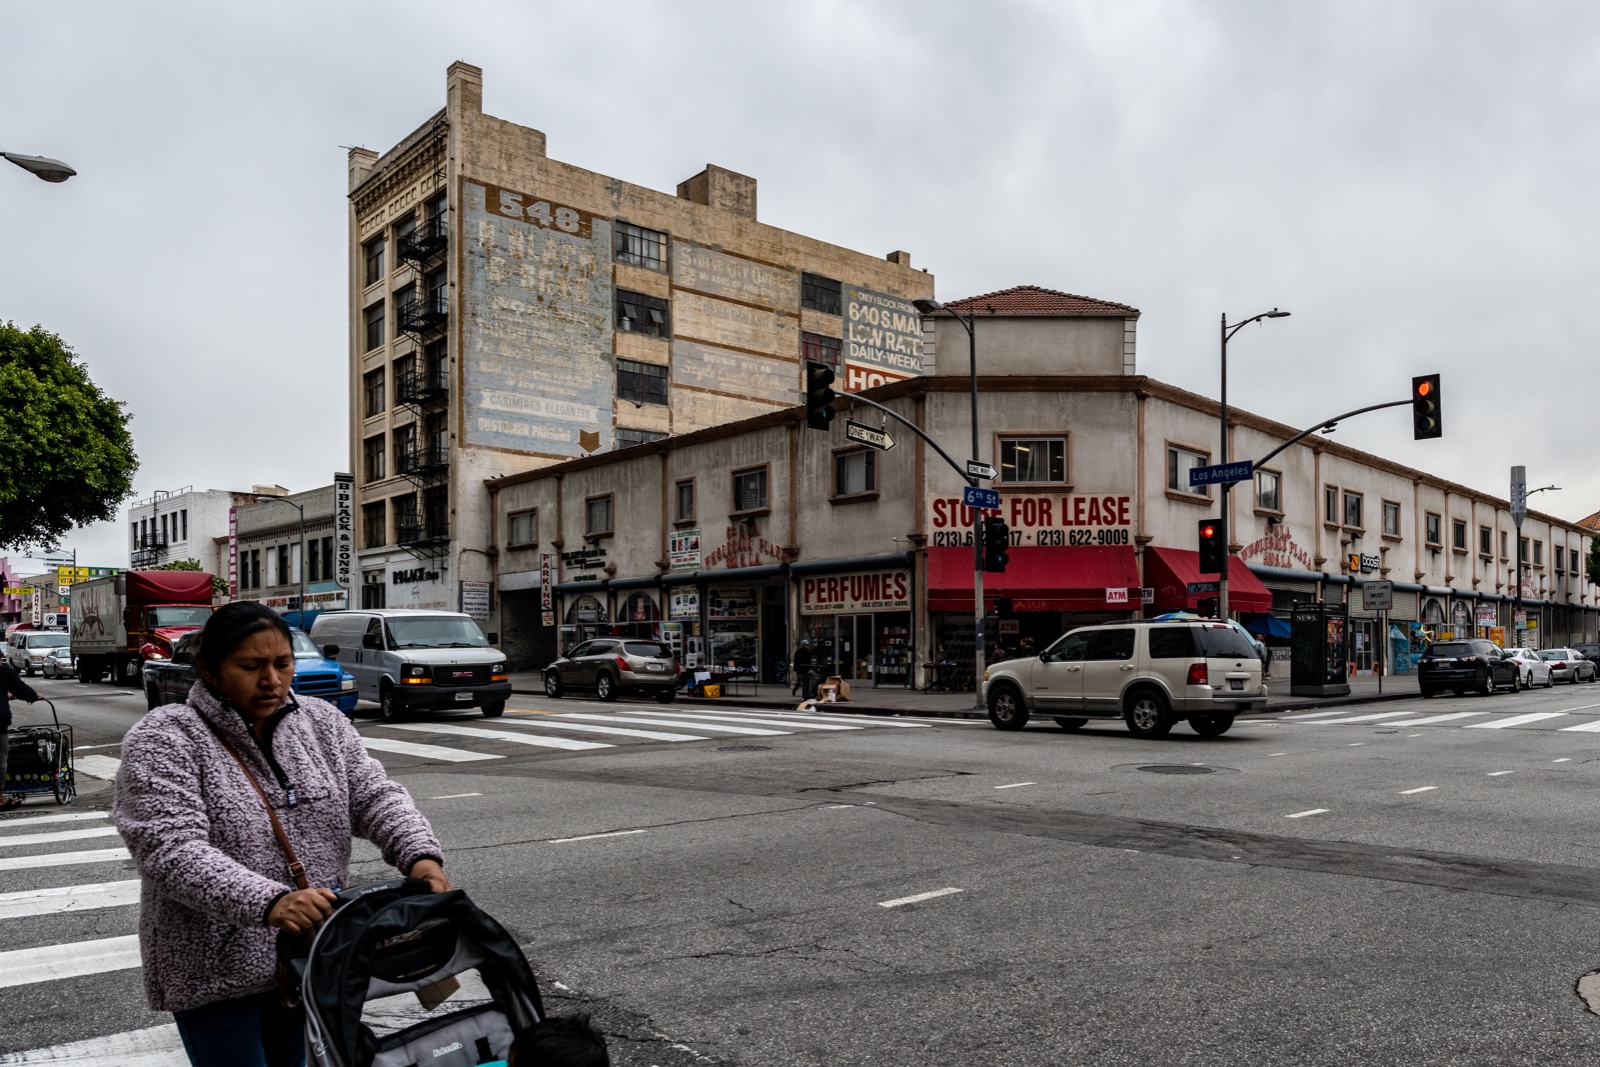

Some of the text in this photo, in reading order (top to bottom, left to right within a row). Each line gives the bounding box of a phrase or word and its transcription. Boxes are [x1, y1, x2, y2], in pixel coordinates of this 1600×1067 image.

[499, 190, 580, 232] 548
[858, 292, 874, 303] ONLY
[877, 297, 896, 310] BLOCK
[897, 303, 915, 314] FROM
[703, 353, 737, 368] BERNIE
[848, 368, 903, 392] HO
[490, 395, 592, 419] CASIMIRES ELEGANTES
[848, 426, 885, 448] ONE WAY
[969, 466, 980, 474] ONE
[1193, 466, 1250, 482] Los Angeles
[967, 490, 997, 504] 6th St
[337, 494, 352, 531] BLACK
[1011, 498, 1053, 526] FOR
[1061, 497, 1131, 525] LEASE
[1037, 530, 1065, 546] (213)
[1069, 529, 1129, 545] 622-9009
[1362, 554, 1380, 568] boost
[543, 554, 551, 606] PARKING
[803, 572, 907, 604] PERFUMES
[1107, 591, 1126, 601] ATM
[1000, 623, 1018, 631] ATM
